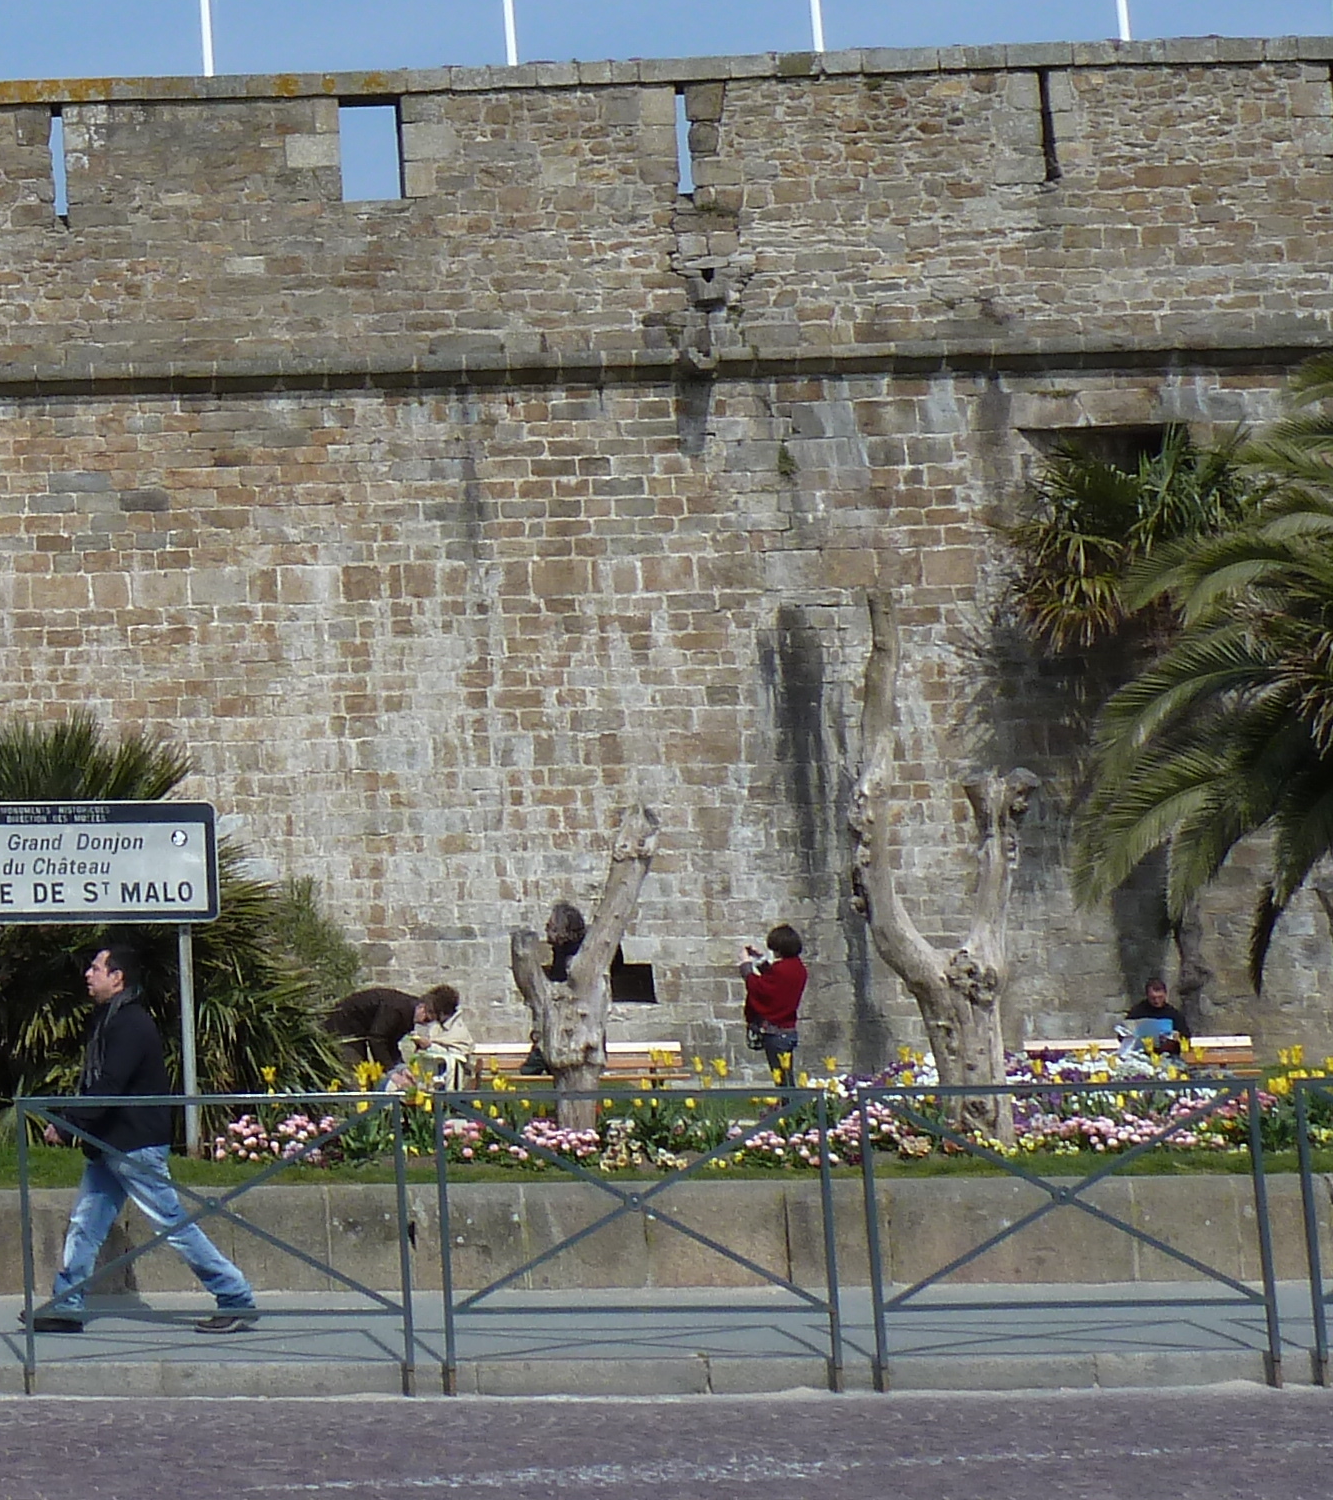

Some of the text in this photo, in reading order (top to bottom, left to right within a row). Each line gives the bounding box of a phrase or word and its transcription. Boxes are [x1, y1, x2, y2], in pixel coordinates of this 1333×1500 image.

[7, 833, 62, 851] Grand
[76, 833, 144, 854] Donjon
[2, 857, 111, 875] du Château
[33, 882, 65, 904] DE
[121, 881, 193, 903] MALO
